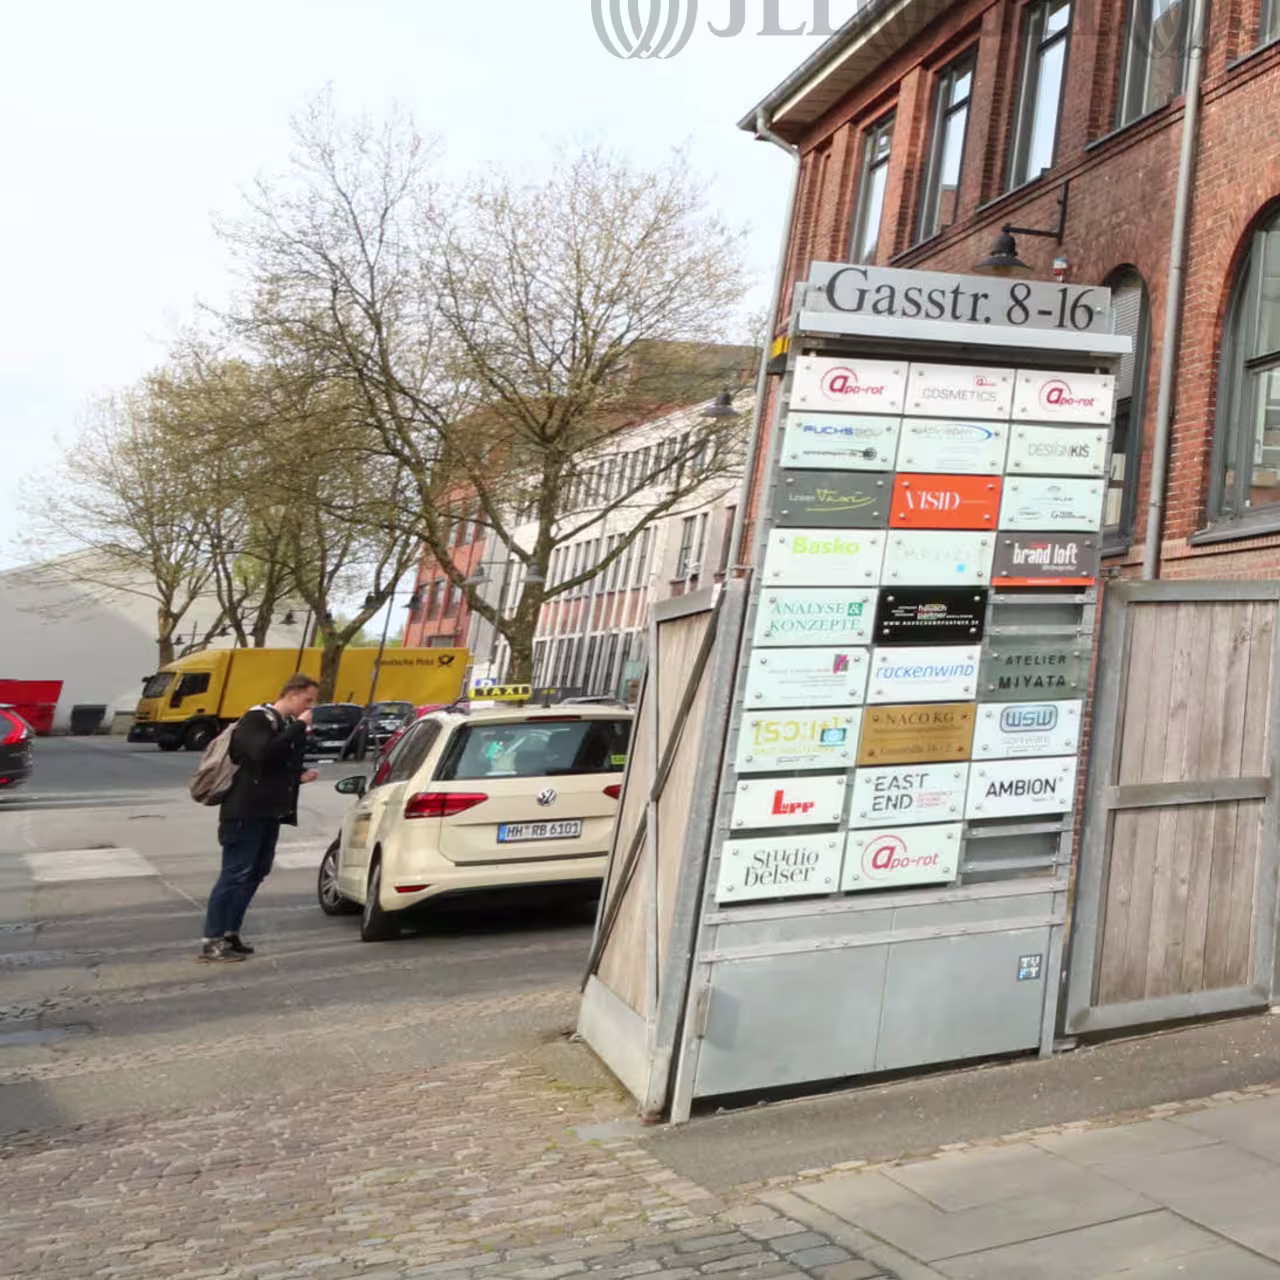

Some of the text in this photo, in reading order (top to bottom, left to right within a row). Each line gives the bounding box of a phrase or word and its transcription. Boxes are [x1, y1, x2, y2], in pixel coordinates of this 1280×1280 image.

[826, 267, 991, 324] Gasstr.
[921, 386, 998, 403] COSMETICS
[1013, 543, 1078, 564] brand loft
[772, 602, 845, 615] ANALYSE
[770, 619, 861, 631] KONZEPTE
[1004, 654, 1067, 666] ATELIER
[998, 674, 1066, 689] MIYATA
[482, 687, 524, 696] TAXI
[886, 711, 955, 725] NACO KG
[873, 773, 931, 792] EAST
[985, 778, 1057, 798] AMBION
[872, 794, 913, 812] END
[752, 847, 820, 869] Studio
[871, 845, 940, 872] apo-rot
